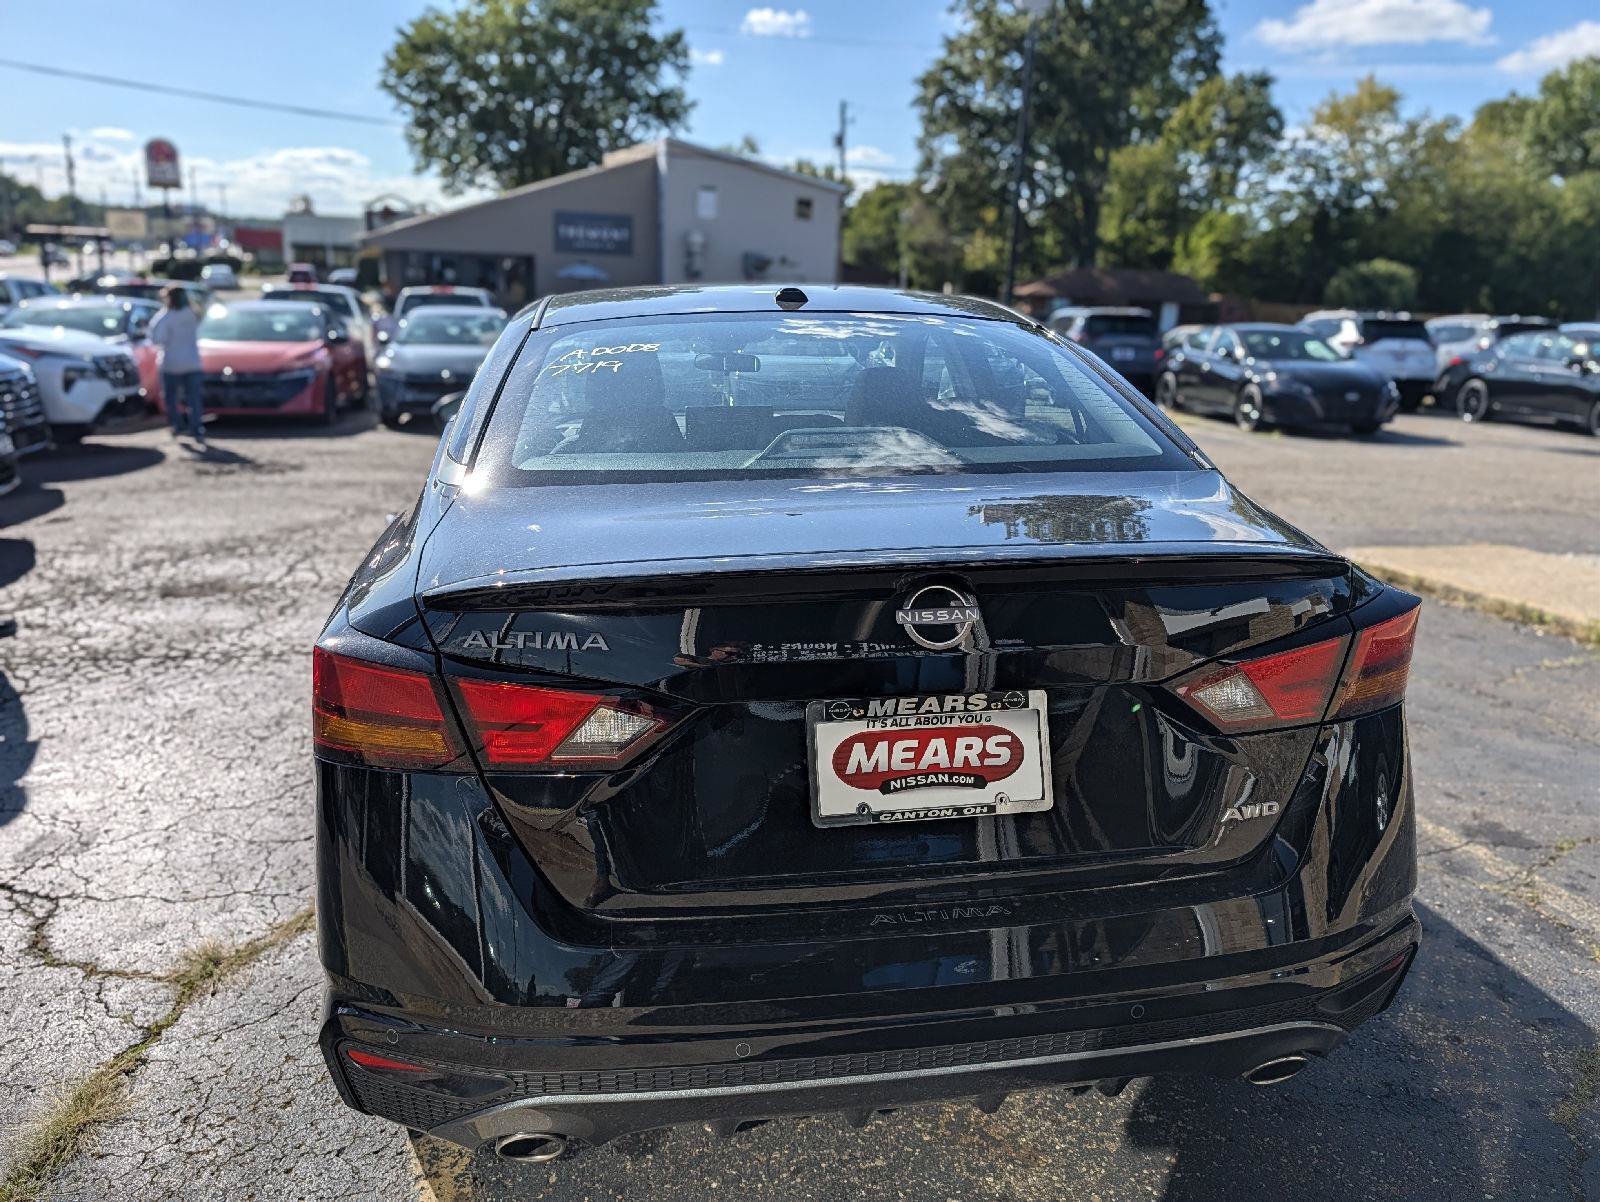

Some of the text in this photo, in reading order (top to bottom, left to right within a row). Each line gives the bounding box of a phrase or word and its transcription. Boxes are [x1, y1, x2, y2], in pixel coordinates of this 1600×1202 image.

[898, 607, 979, 622] NISSAN
[462, 630, 610, 651] ALTIMA
[866, 693, 988, 717] MEARS
[866, 714, 983, 729] IT'S ALL ABOUT YOU
[845, 734, 1012, 775] MEARS
[889, 773, 975, 791] NISSAN.COM
[879, 805, 988, 822] CANTON, OH
[1221, 800, 1280, 823] AWD
[869, 904, 1012, 926] ALTIMA
